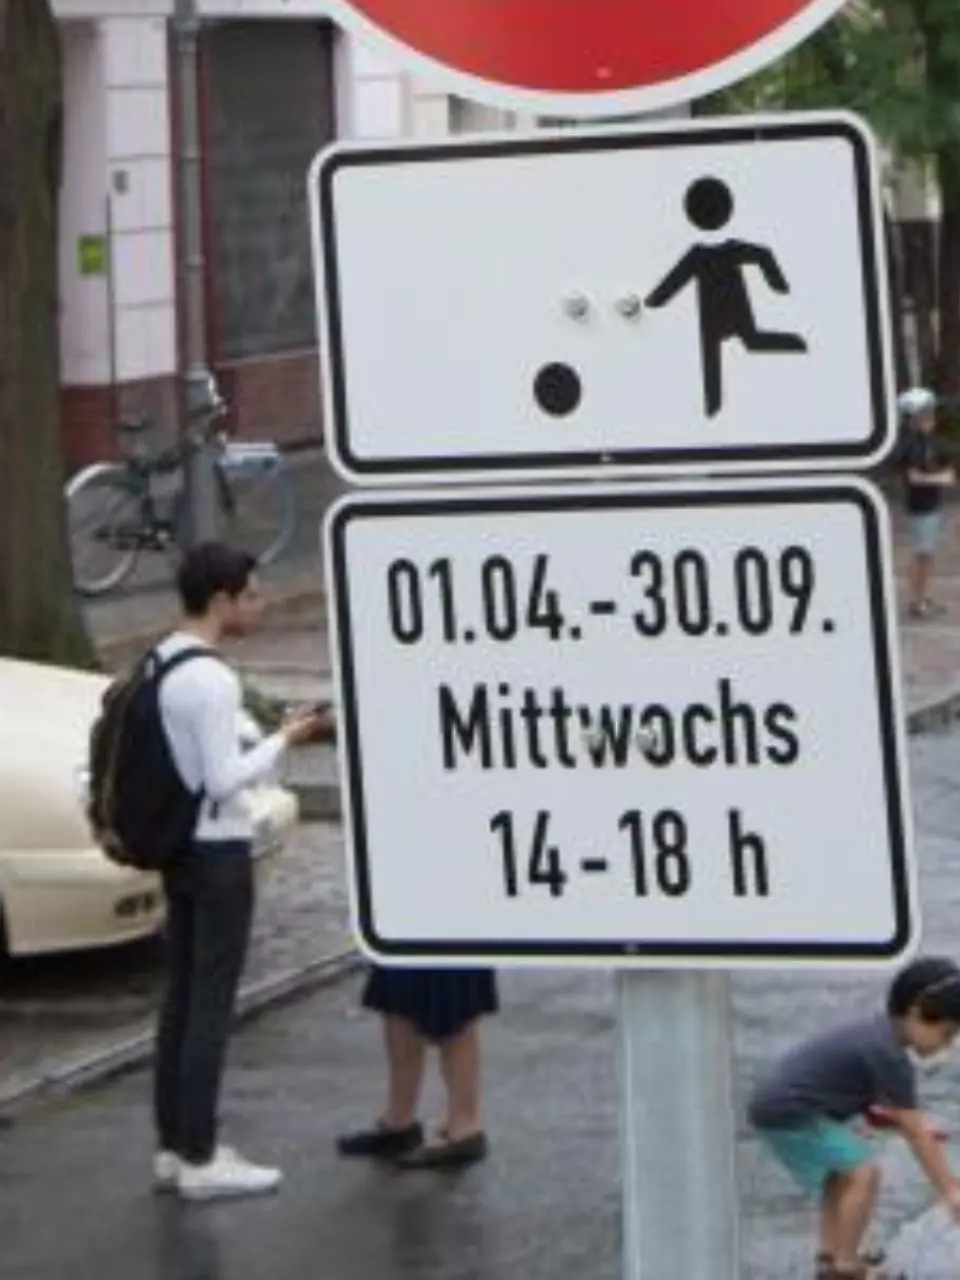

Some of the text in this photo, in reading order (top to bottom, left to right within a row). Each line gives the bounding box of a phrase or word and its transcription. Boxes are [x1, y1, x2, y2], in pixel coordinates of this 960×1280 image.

[437, 677, 800, 771] Mittwochs
[489, 808, 770, 899] 14-18 h
